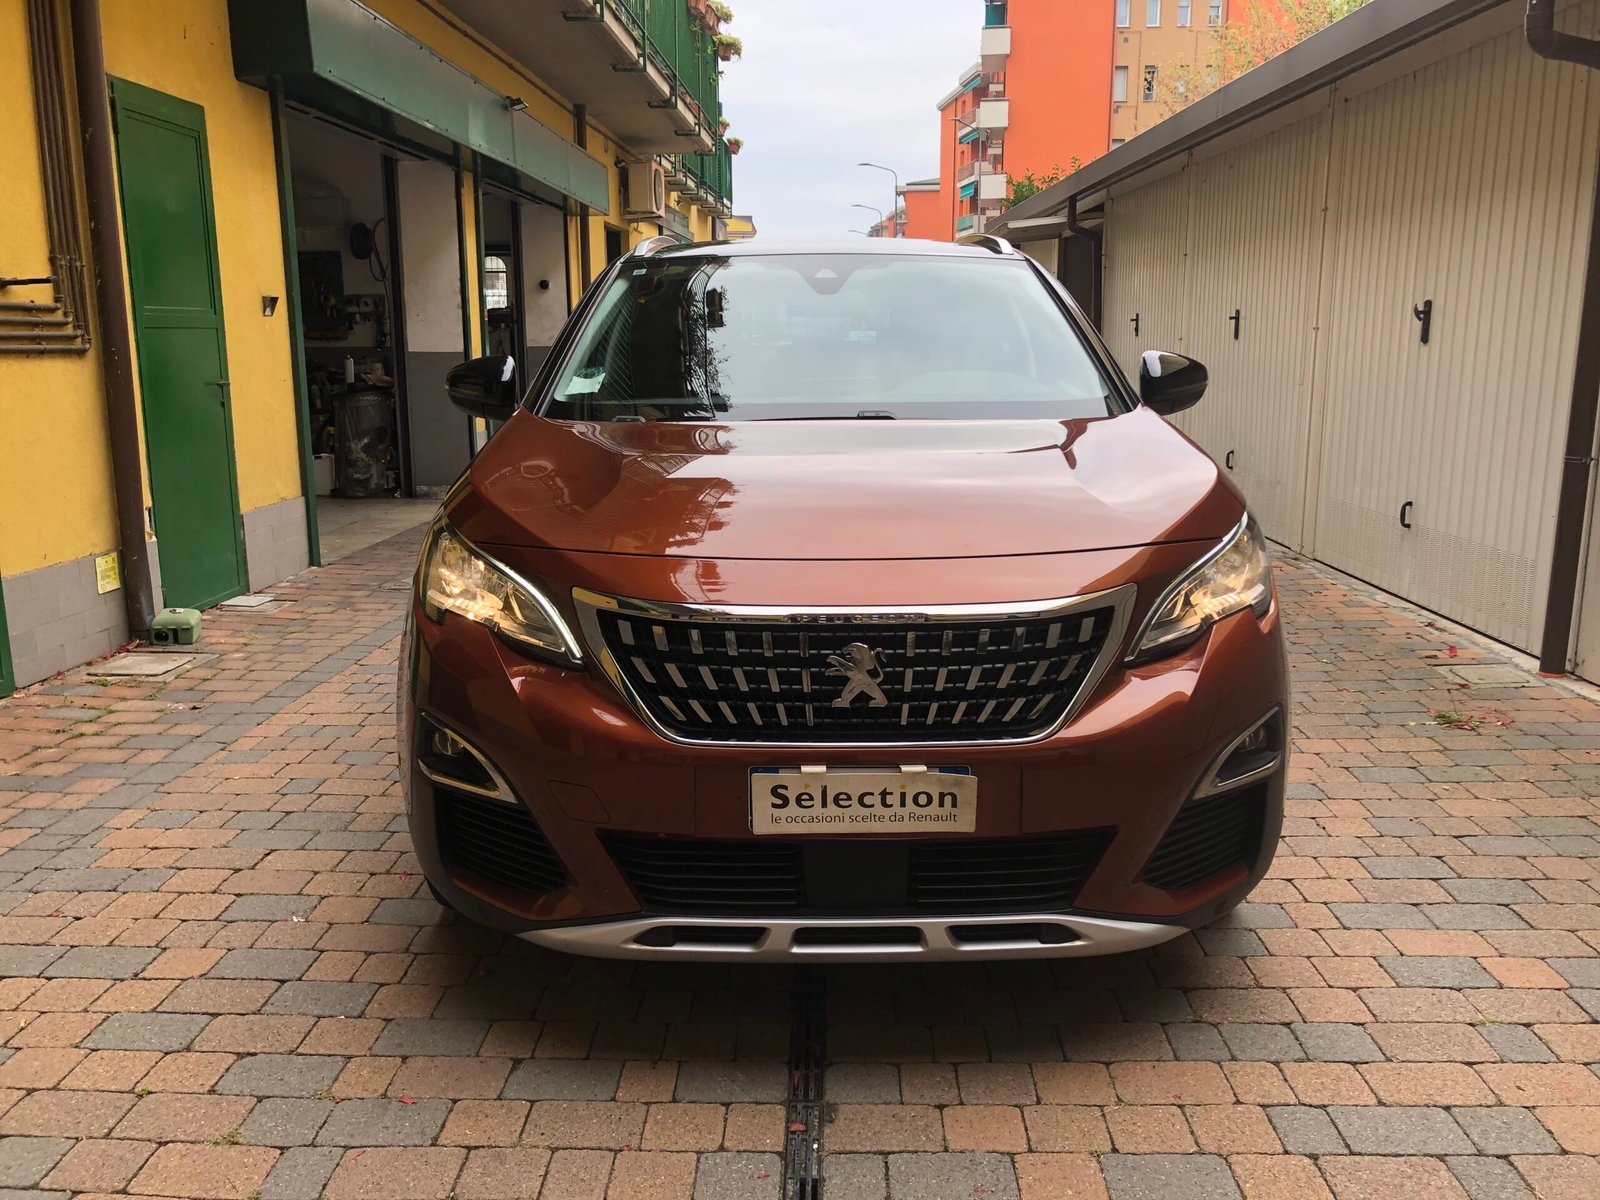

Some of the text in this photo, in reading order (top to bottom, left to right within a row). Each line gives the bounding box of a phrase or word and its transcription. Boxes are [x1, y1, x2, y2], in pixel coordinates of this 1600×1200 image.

[771, 811, 958, 824] le occasioni scelte da Renault
